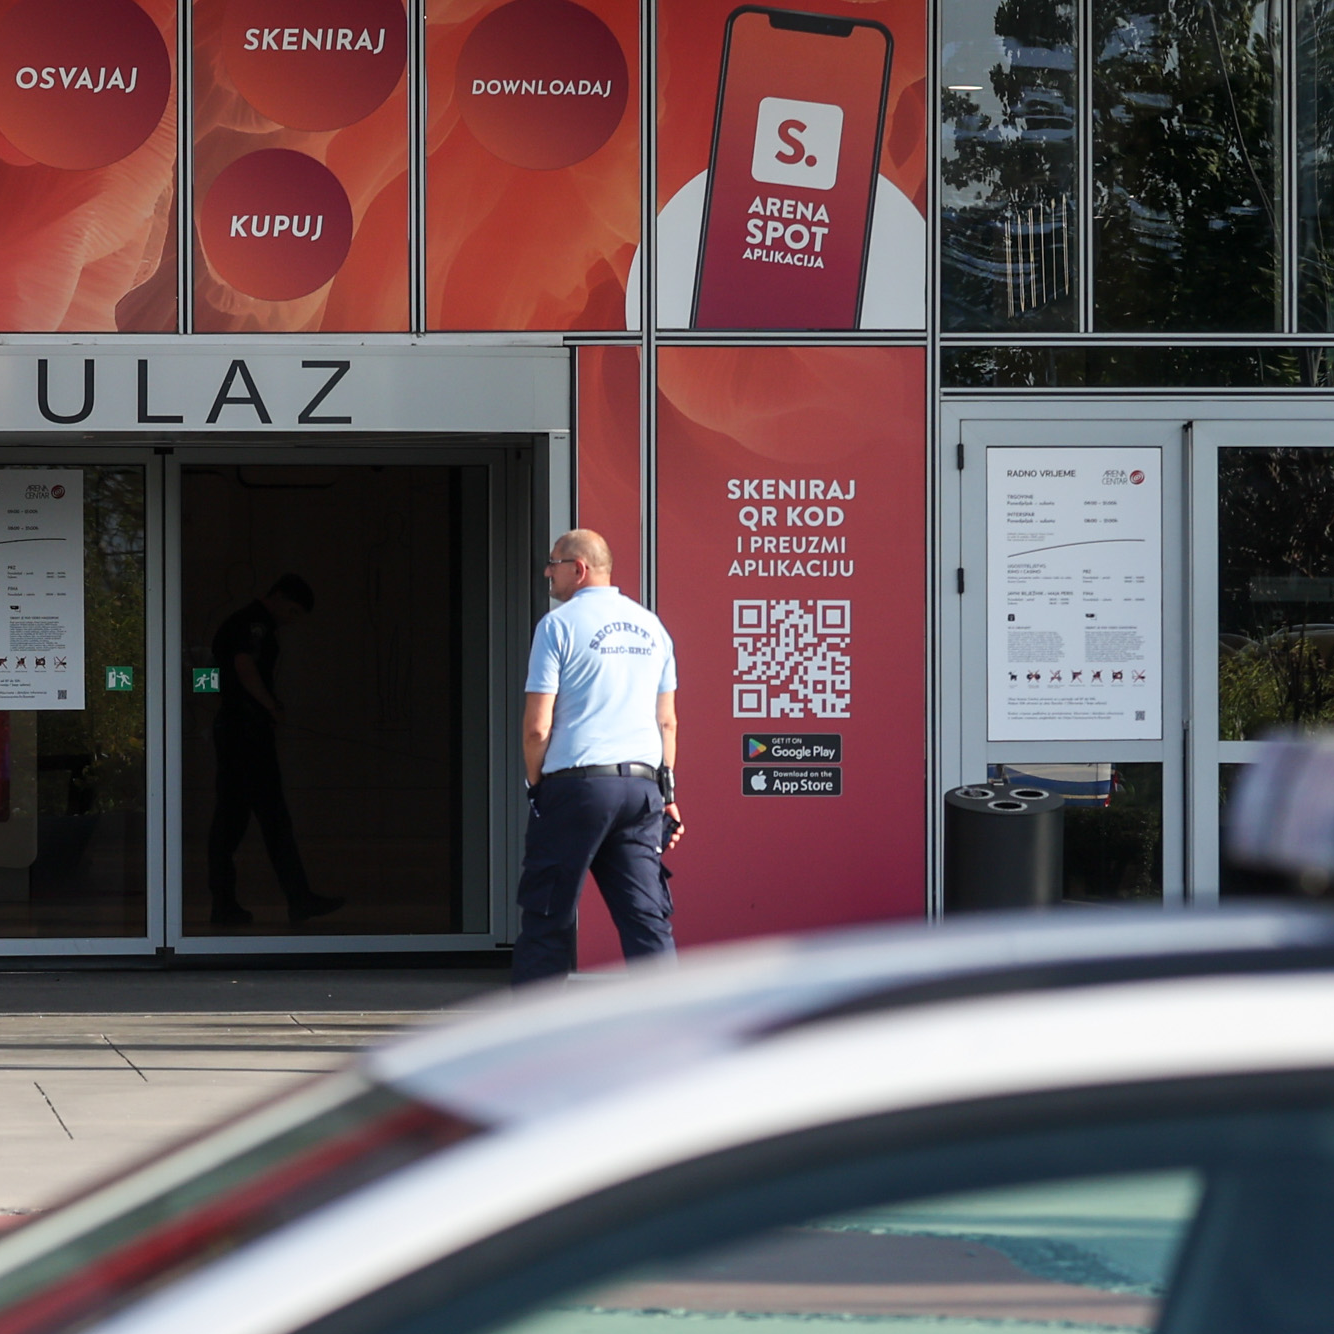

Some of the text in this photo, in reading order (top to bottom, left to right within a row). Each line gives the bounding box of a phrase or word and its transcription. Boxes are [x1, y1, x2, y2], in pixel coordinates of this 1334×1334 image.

[244, 28, 386, 54] SKENIRAJ
[15, 67, 138, 93] OSVAJAJ
[471, 79, 612, 98] DOWNLOADAJ
[775, 119, 817, 168] S.
[747, 196, 830, 223] ARENA
[230, 214, 324, 241] KUPUJ
[745, 218, 829, 252] SPOT
[742, 247, 825, 269] APLIKACIJA
[36, 358, 353, 425] ULAZ
[1006, 470, 1076, 478] RADNO VRIJEME
[1101, 477, 1128, 485] CENTAR
[1102, 469, 1127, 477] ARENA
[25, 491, 50, 499] CENTAR
[26, 484, 49, 492] ARENA
[727, 479, 856, 500] SKENIRAJ
[738, 506, 845, 532] QR KOD
[737, 536, 846, 554] I PREUZMI
[727, 560, 855, 577] APLIKACIJU
[771, 746, 835, 759] Google Play
[772, 779, 834, 793] App Store
